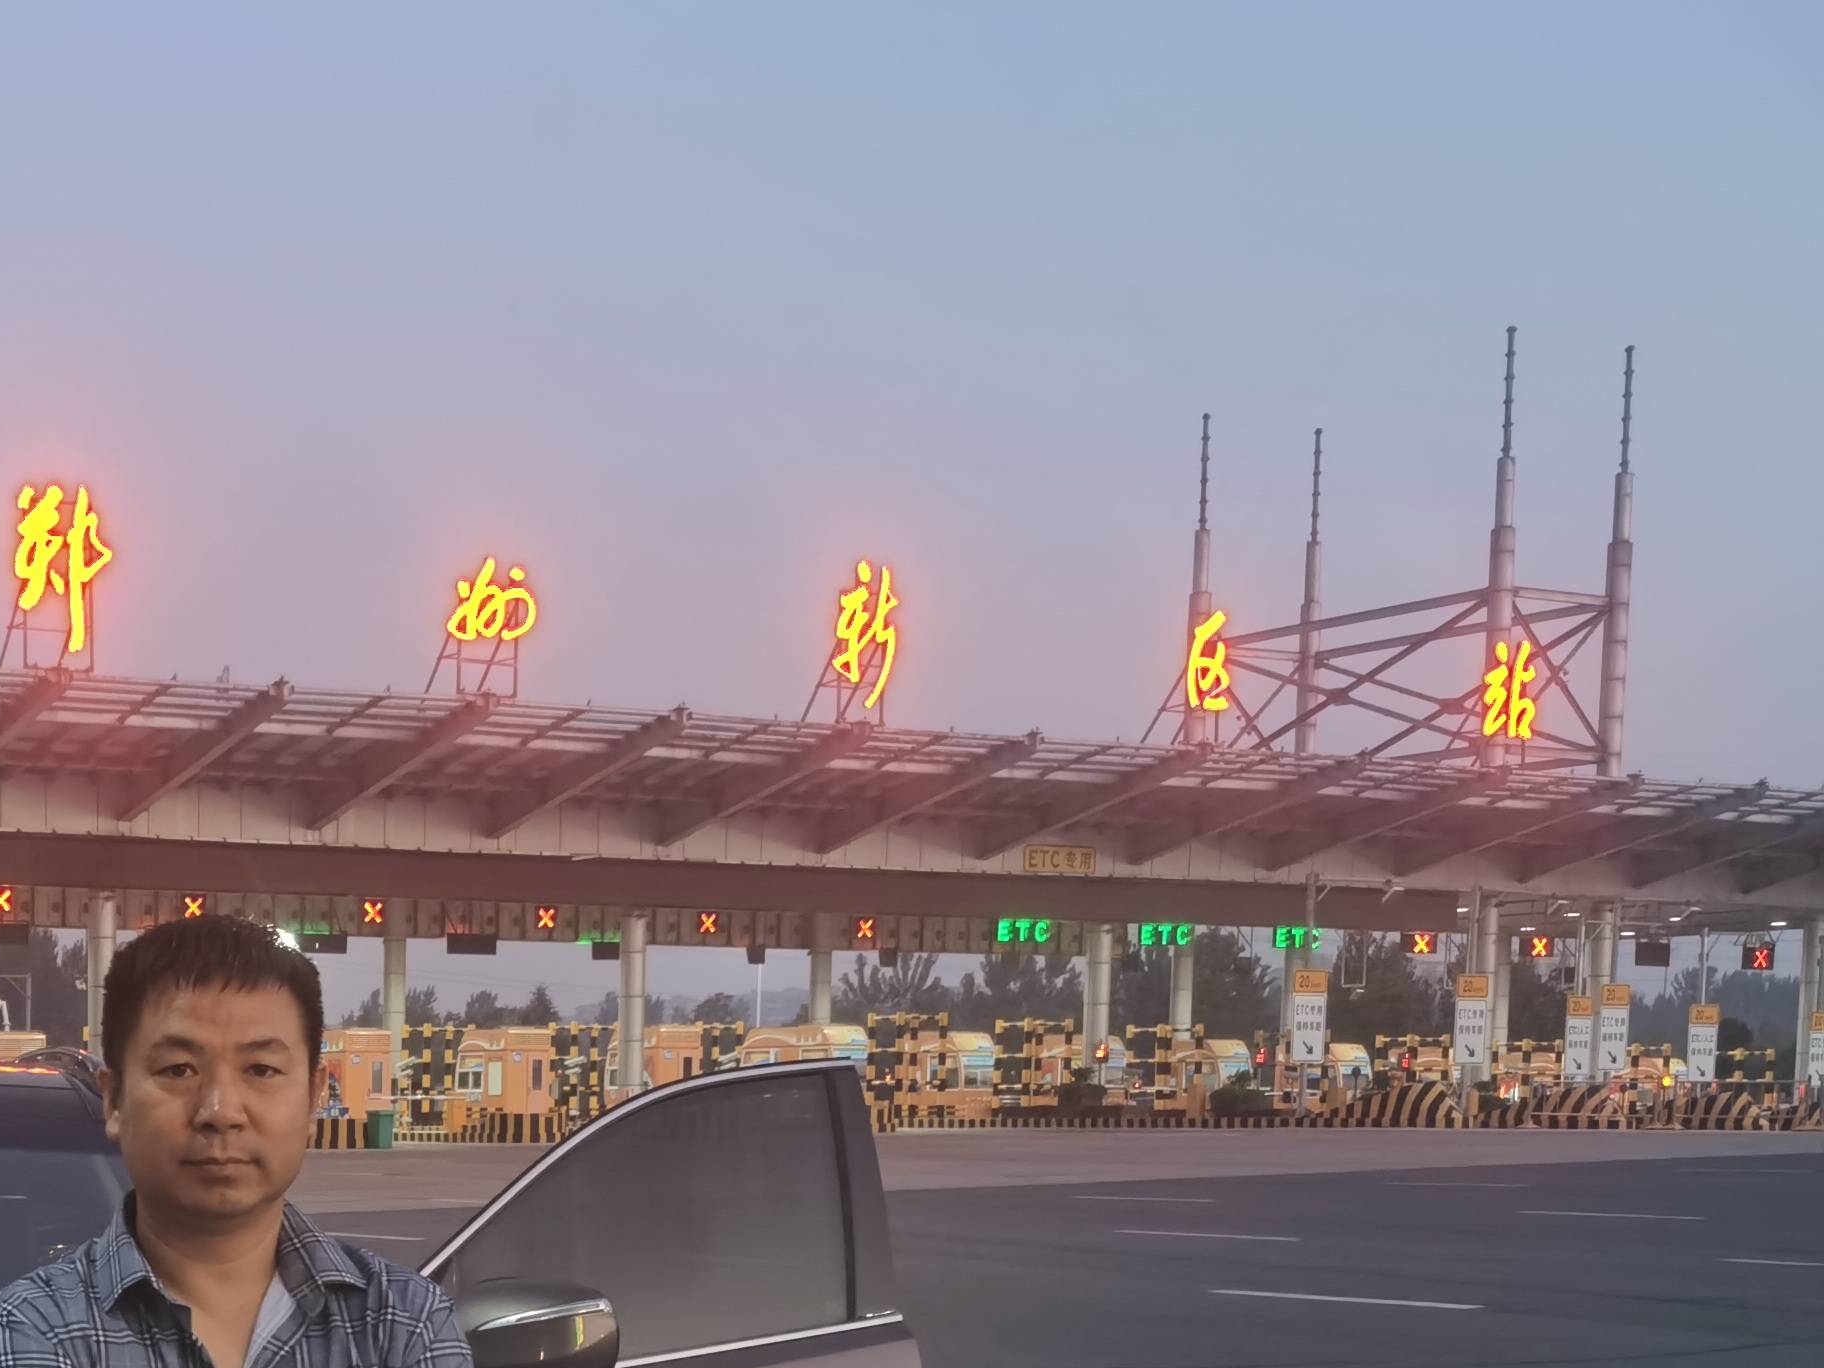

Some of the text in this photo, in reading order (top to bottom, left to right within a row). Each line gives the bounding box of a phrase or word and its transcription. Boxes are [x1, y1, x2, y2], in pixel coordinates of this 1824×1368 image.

[9, 482, 1538, 742] 郑州新区站
[1028, 849, 1092, 869] ETC专用
[997, 918, 1051, 943] ETC
[1140, 922, 1191, 946] ETC
